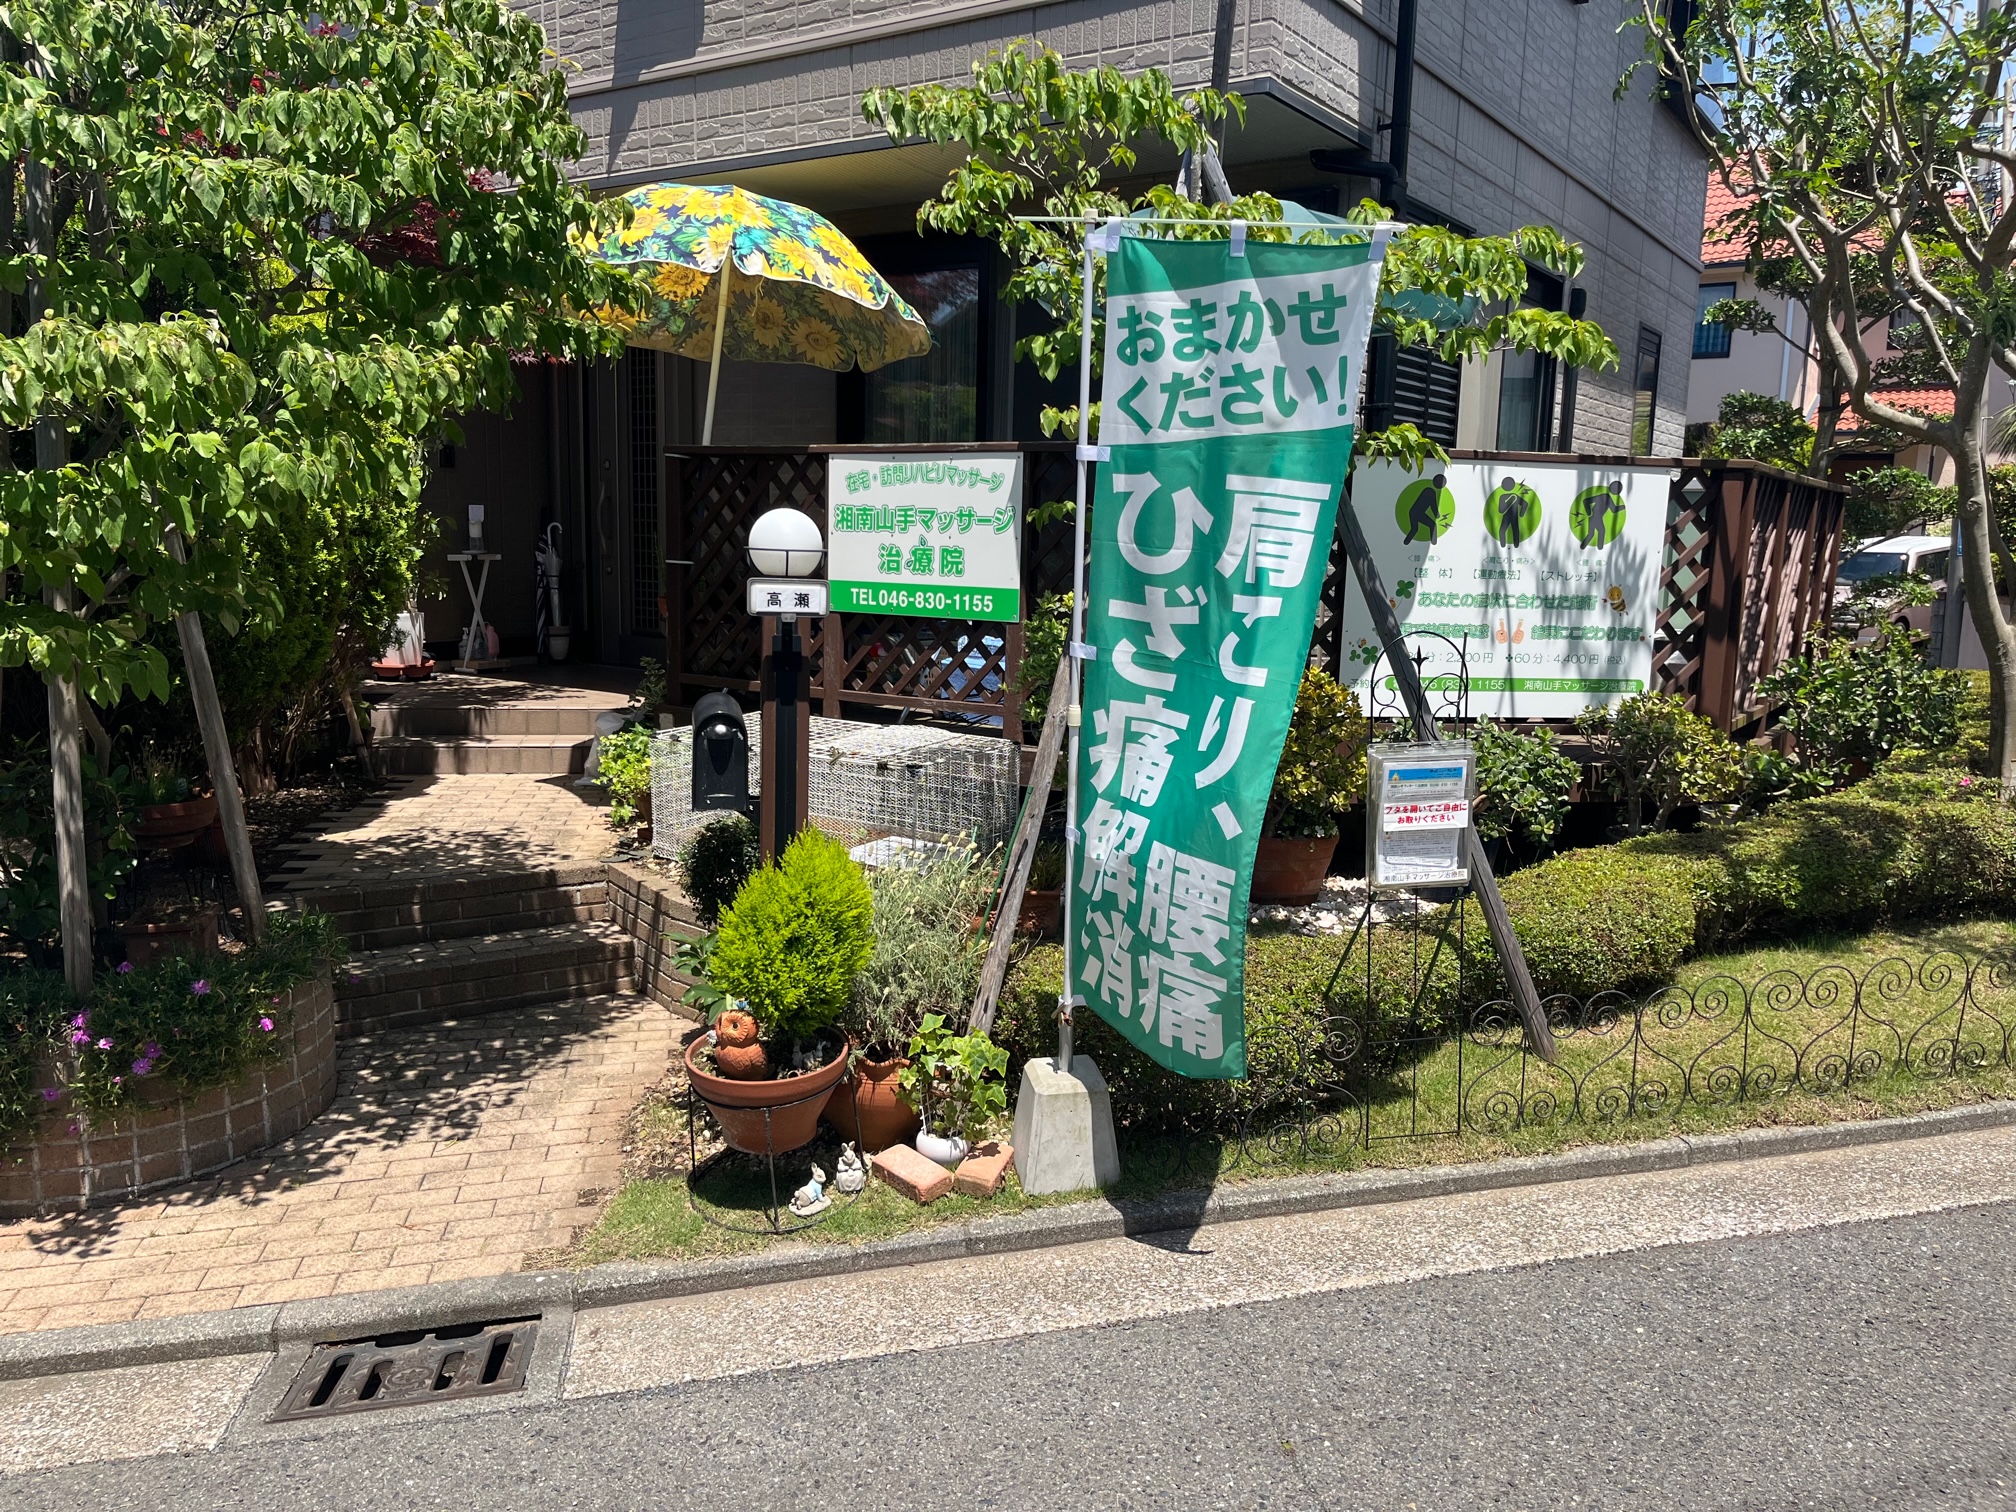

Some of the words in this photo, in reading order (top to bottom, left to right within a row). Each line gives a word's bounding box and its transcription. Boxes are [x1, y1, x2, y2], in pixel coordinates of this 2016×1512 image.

[1117, 283, 1347, 366] おまかせ
[1117, 355, 1347, 435] ください！
[845, 463, 1004, 494] 在宅・訪問リハビリマッサージ
[834, 504, 1015, 534] 湘南山手マッサージ
[878, 543, 965, 576] 治療院
[767, 592, 810, 609] 高瀬
[851, 588, 876, 606] TEL
[879, 589, 993, 613] 046-830-1155
[1524, 680, 1637, 692] 湘南山手マッサージ治療院
[1079, 471, 1213, 1019] ひざ痛解消
[1385, 803, 1467, 815] フタを開いてご自由に
[1397, 814, 1455, 825] お取りください
